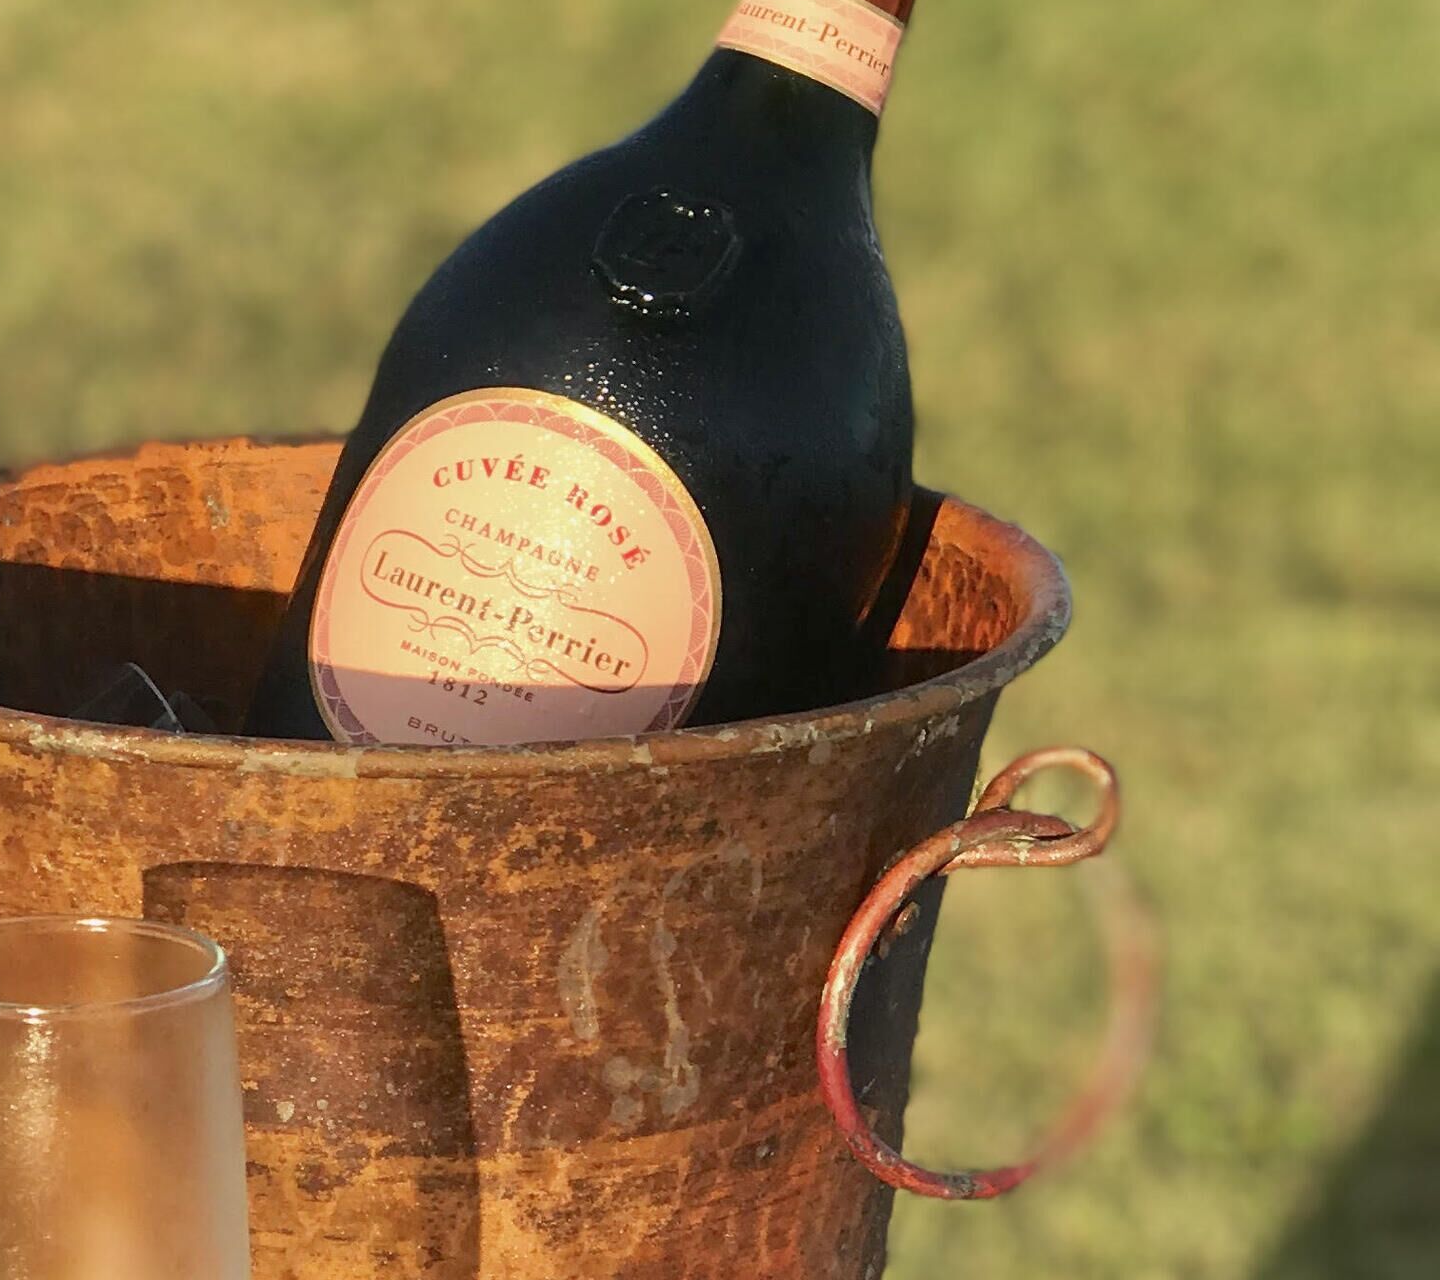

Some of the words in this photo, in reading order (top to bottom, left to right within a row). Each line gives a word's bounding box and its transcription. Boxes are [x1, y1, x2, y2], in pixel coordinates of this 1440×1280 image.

[738, 2, 890, 78] aurent-Perrier
[432, 453, 551, 489] CUVÉE
[565, 483, 651, 570] ROSÉ
[444, 508, 600, 582] CHAMPAGNE
[372, 550, 632, 678] Laurent-Perrier
[400, 639, 461, 672] MAISON
[467, 667, 536, 703] FONDÉE
[427, 670, 489, 706] 1812
